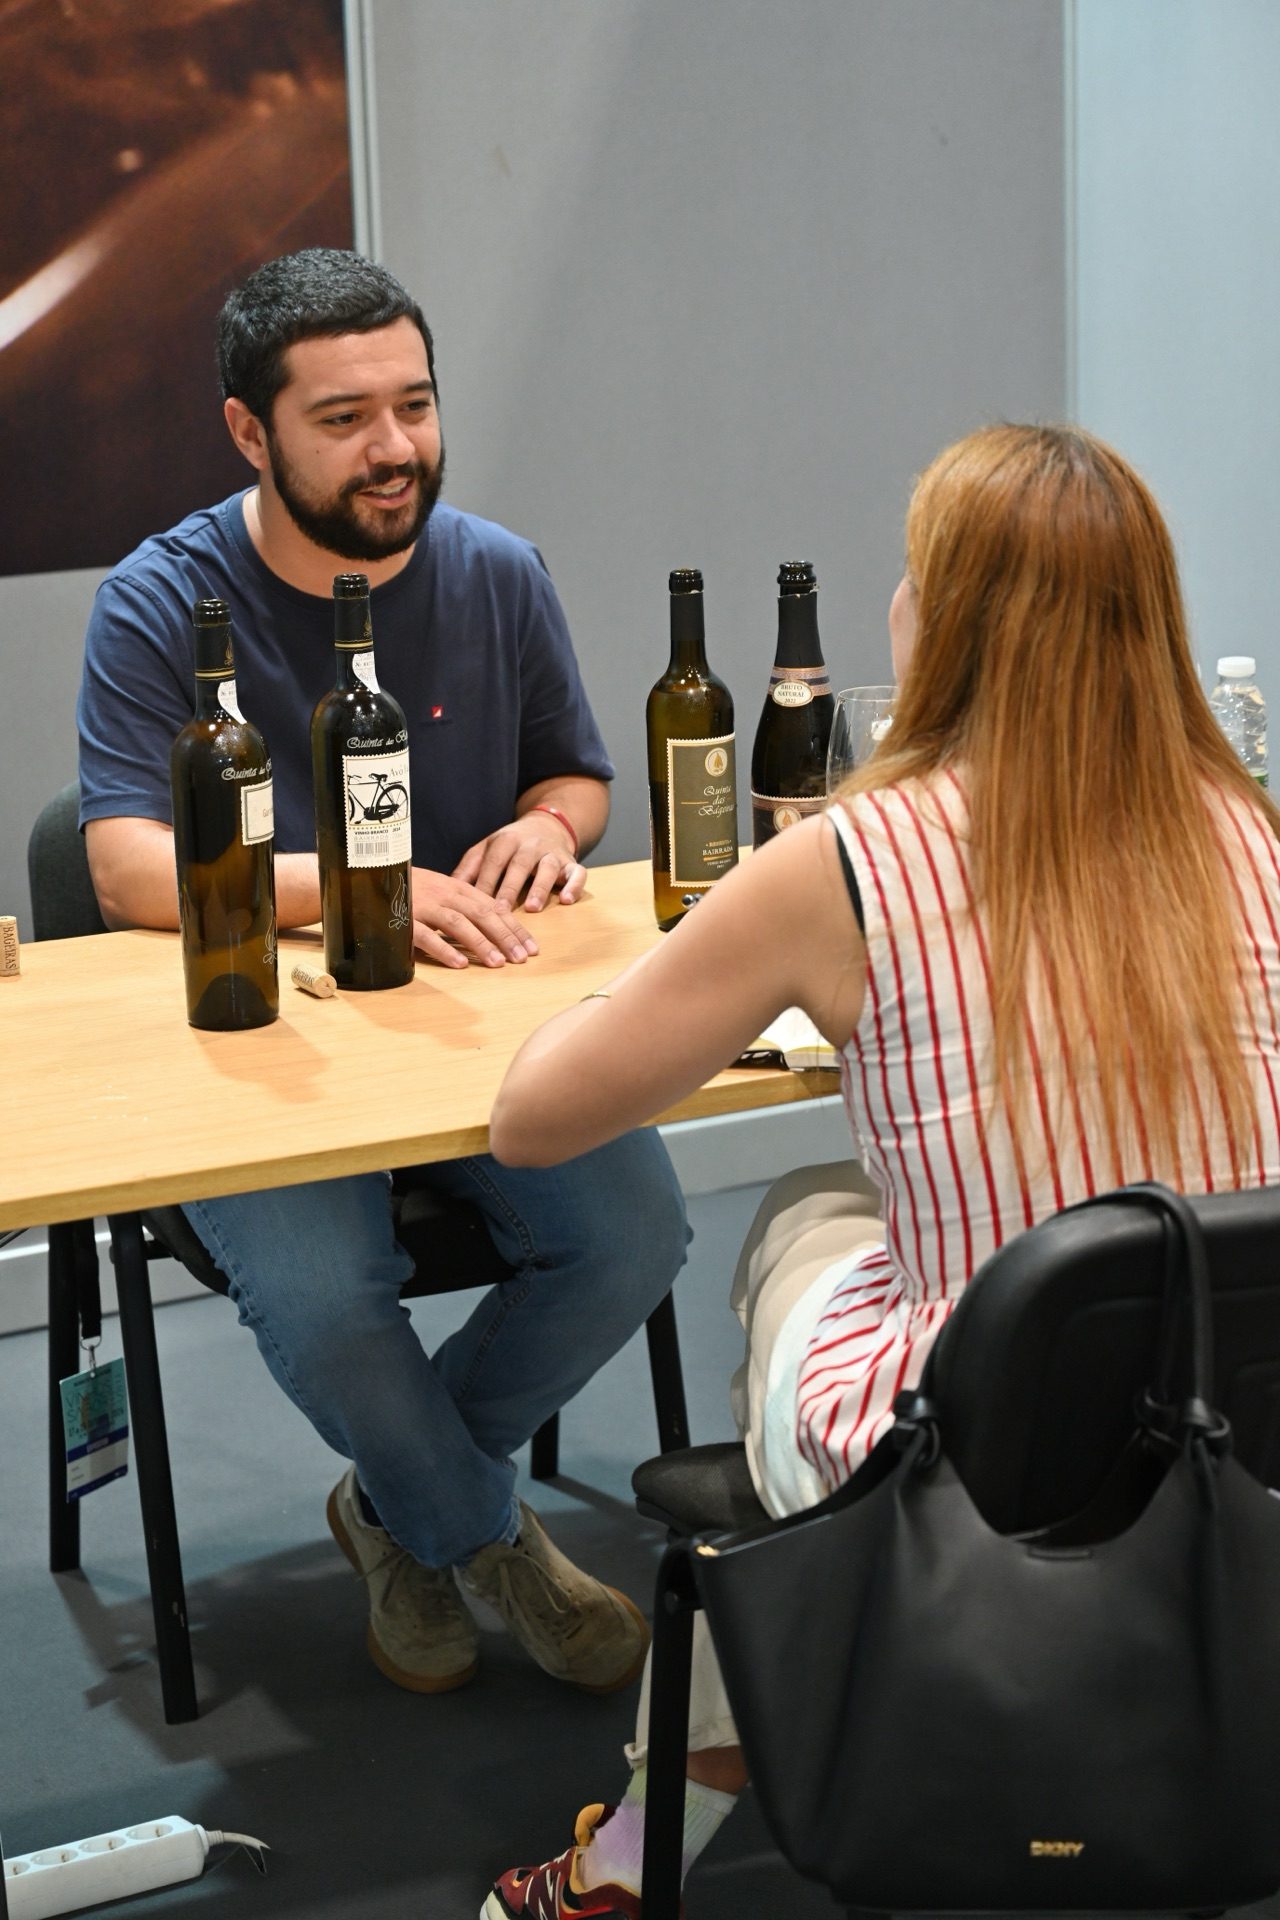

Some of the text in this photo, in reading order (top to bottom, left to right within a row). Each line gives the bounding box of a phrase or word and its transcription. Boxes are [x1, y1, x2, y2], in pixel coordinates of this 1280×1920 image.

[777, 690, 805, 698] NATURAL
[346, 736, 383, 749] Quinta
[221, 767, 258, 781] Quinta
[703, 785, 731, 796] Quinta
[712, 795, 725, 806] das
[702, 846, 734, 856] BAIRRADA
